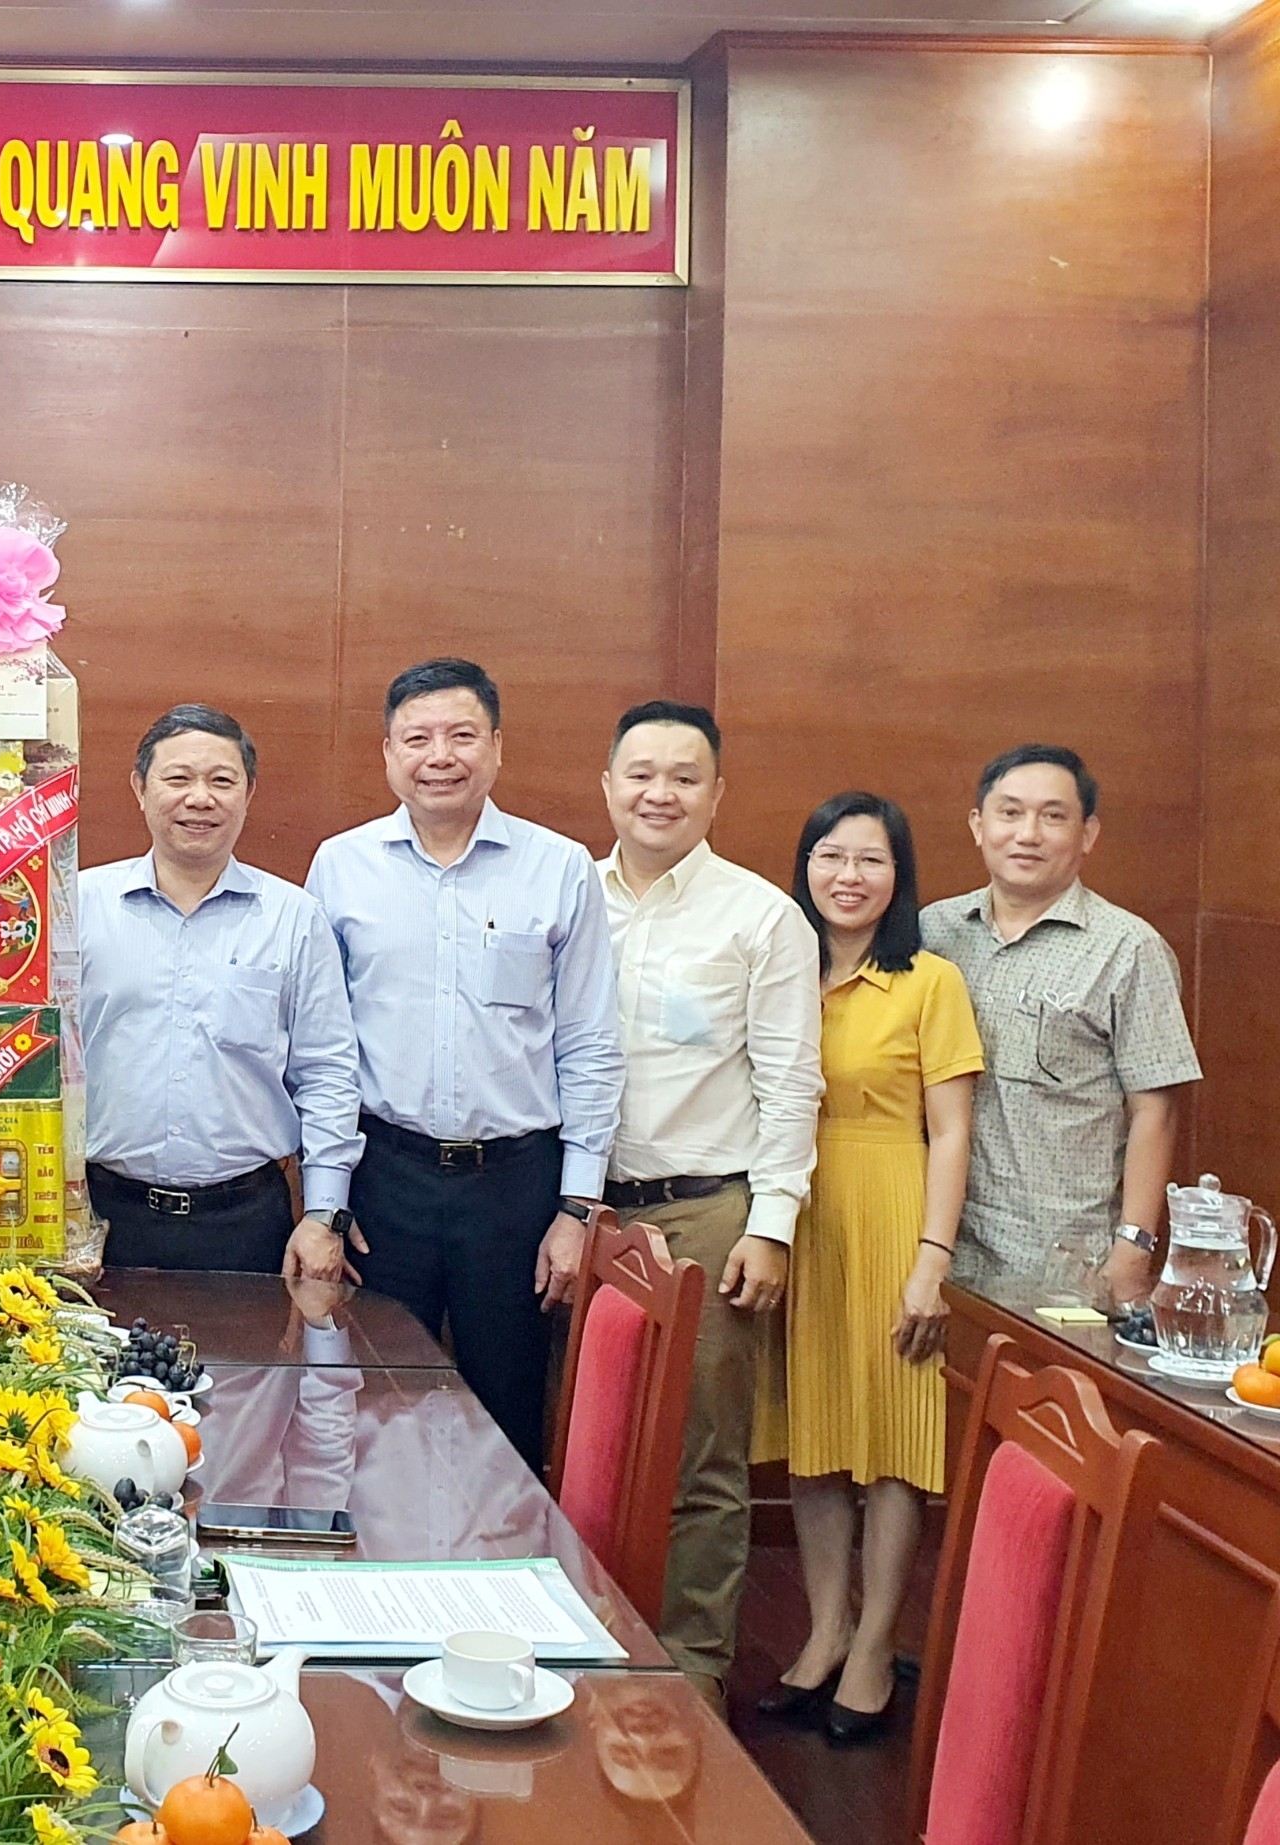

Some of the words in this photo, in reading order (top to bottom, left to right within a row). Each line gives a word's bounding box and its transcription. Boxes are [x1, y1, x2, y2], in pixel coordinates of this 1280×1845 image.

[199, 142, 329, 231] VINH
[349, 119, 511, 233] MUÔN
[527, 124, 652, 233] NĂM
[9, 809, 35, 841] HỒ
[29, 793, 52, 825] CHÍ
[44, 789, 73, 818] MINH
